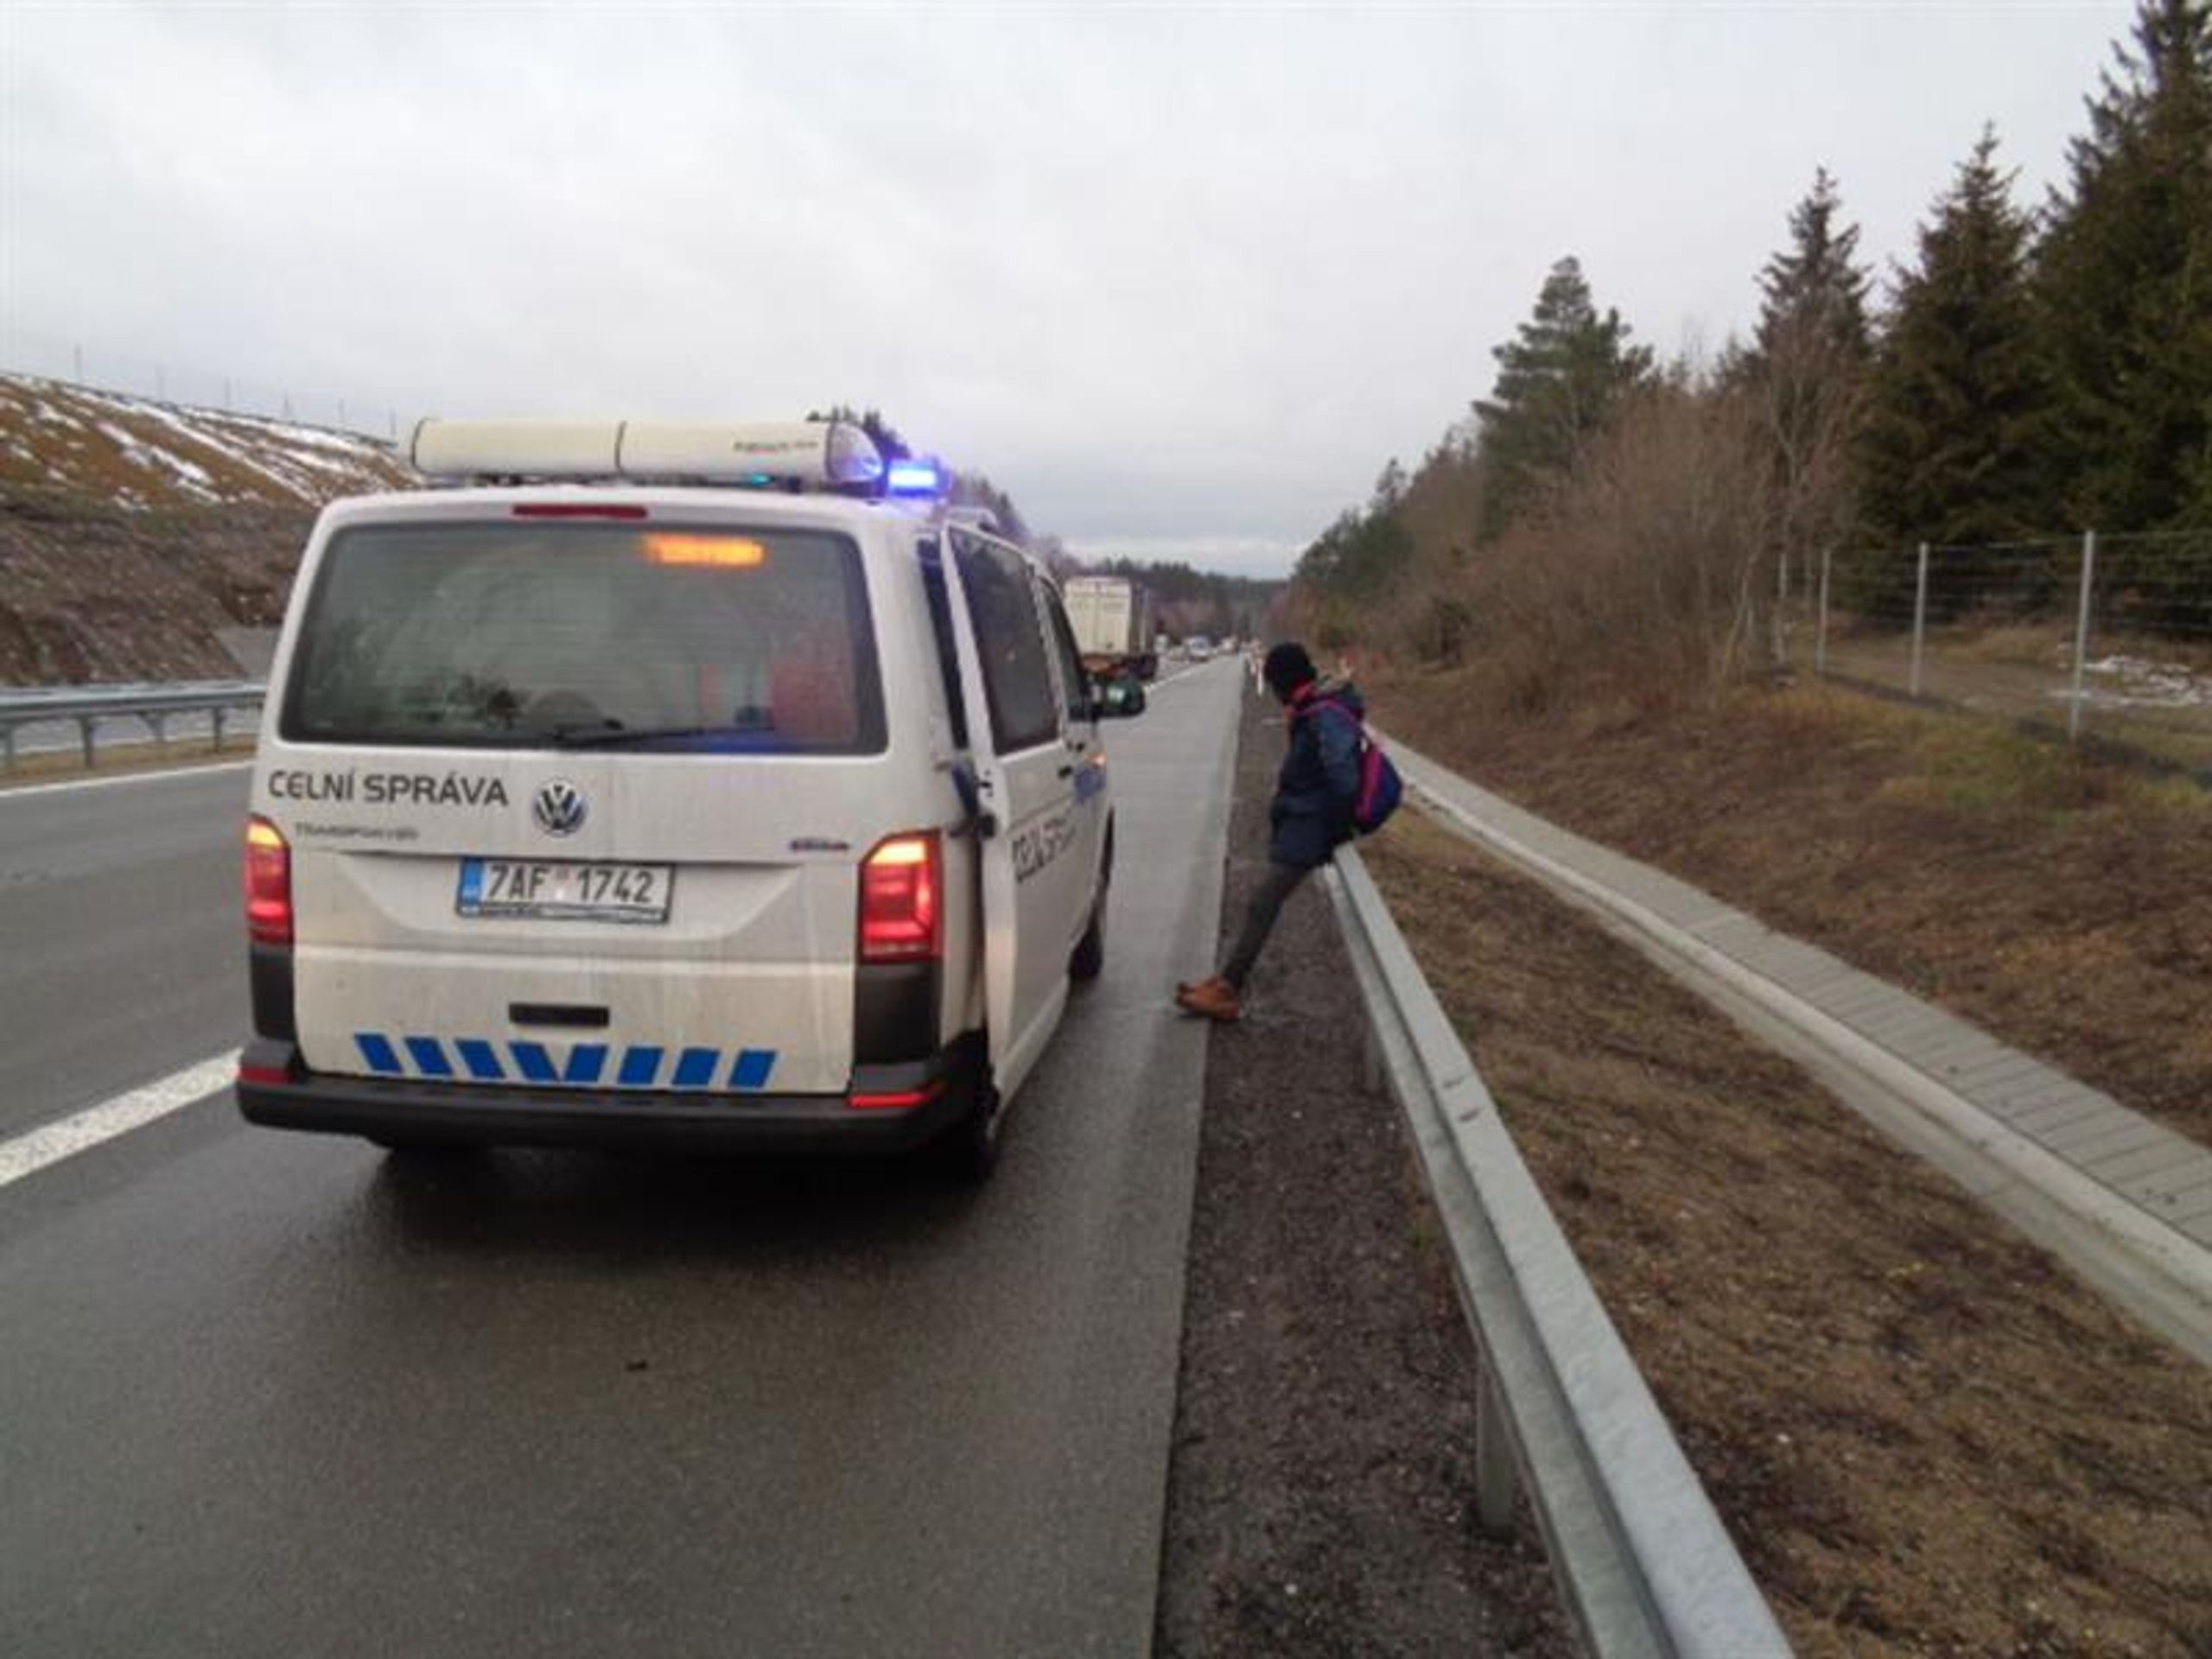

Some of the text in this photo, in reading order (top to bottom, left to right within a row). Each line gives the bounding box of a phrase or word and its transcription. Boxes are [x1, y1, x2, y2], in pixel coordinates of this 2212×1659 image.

[268, 766, 509, 806] CELNÍ SPRÁVA
[488, 863, 654, 903] 7AF 1742
